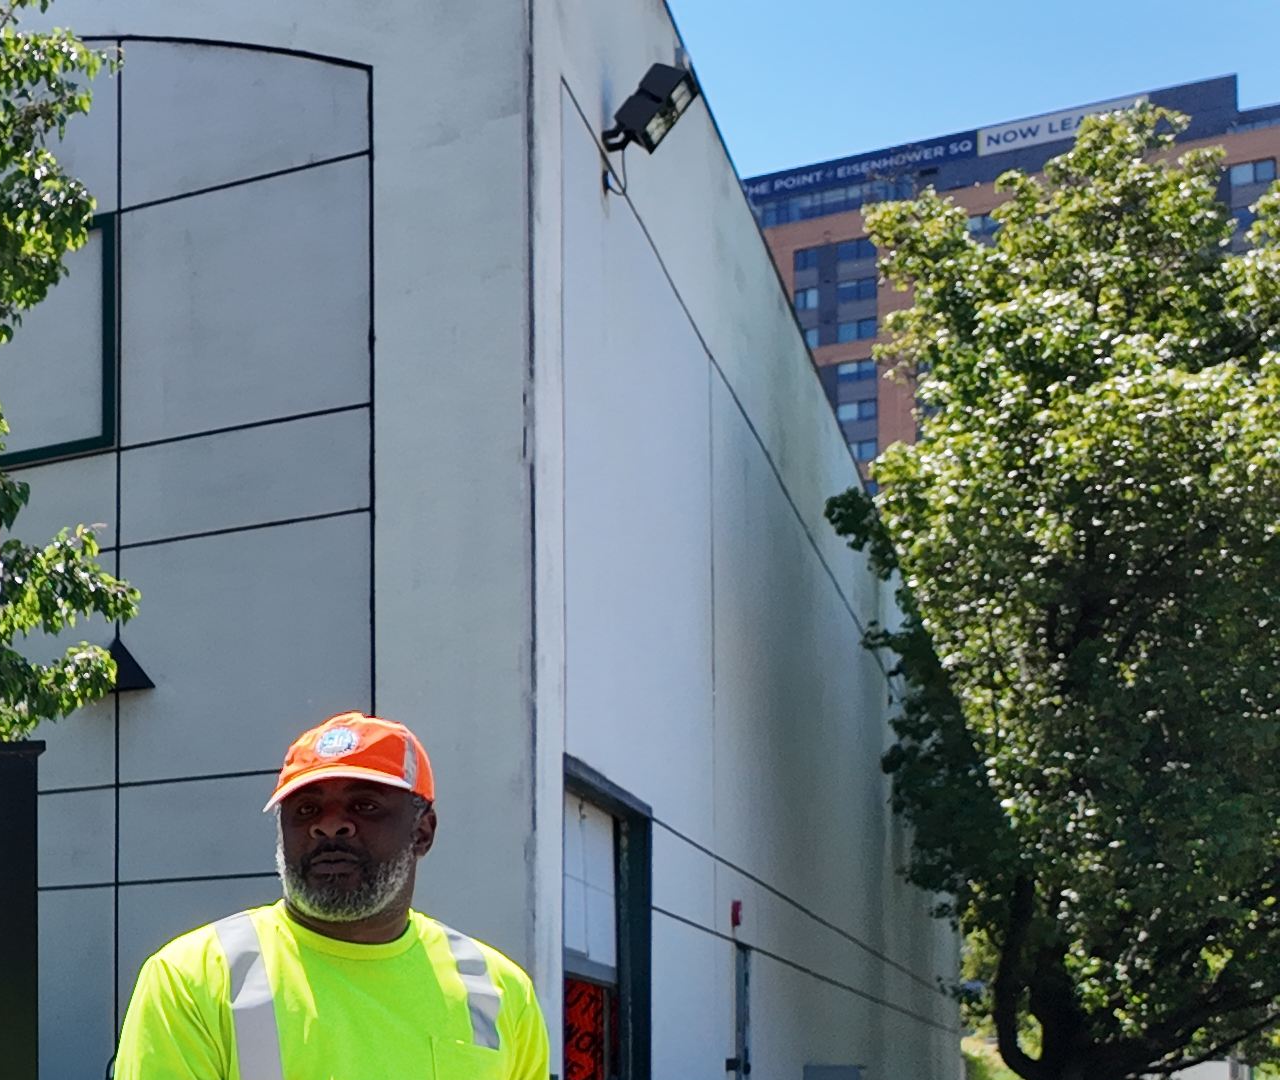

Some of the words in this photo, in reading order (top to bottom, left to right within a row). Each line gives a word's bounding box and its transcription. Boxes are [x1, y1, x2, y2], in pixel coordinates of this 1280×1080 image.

[986, 125, 1040, 147] NOW
[774, 170, 823, 192] POINT
[837, 145, 945, 178] EISENHOWER
[949, 140, 973, 154] SQ
